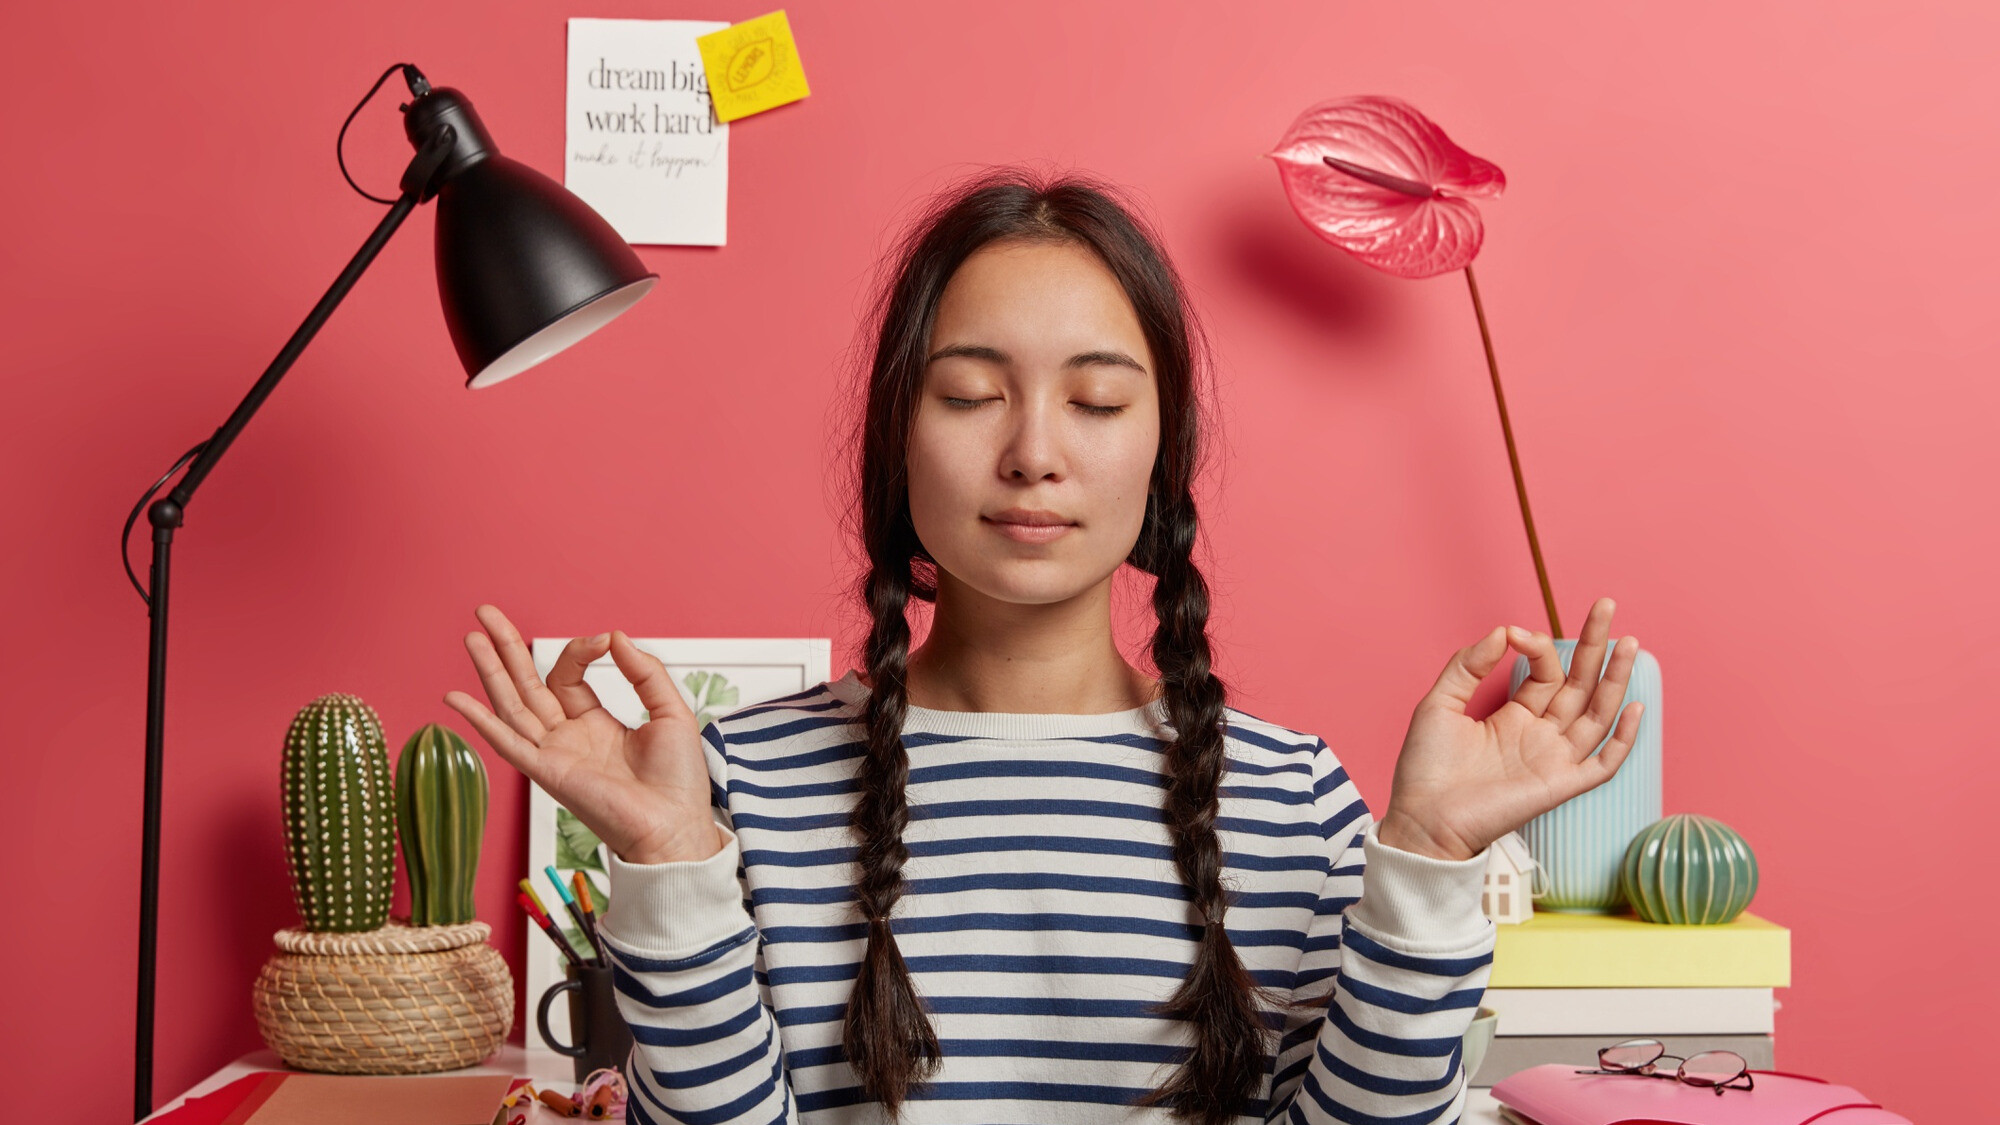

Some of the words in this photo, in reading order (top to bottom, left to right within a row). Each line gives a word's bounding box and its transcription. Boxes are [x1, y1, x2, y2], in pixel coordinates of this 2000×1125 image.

[588, 57, 665, 91] dream
[671, 61, 712, 104] big
[585, 103, 647, 133] work
[654, 104, 714, 135] hard
[573, 142, 618, 165] make
[628, 138, 648, 169] it
